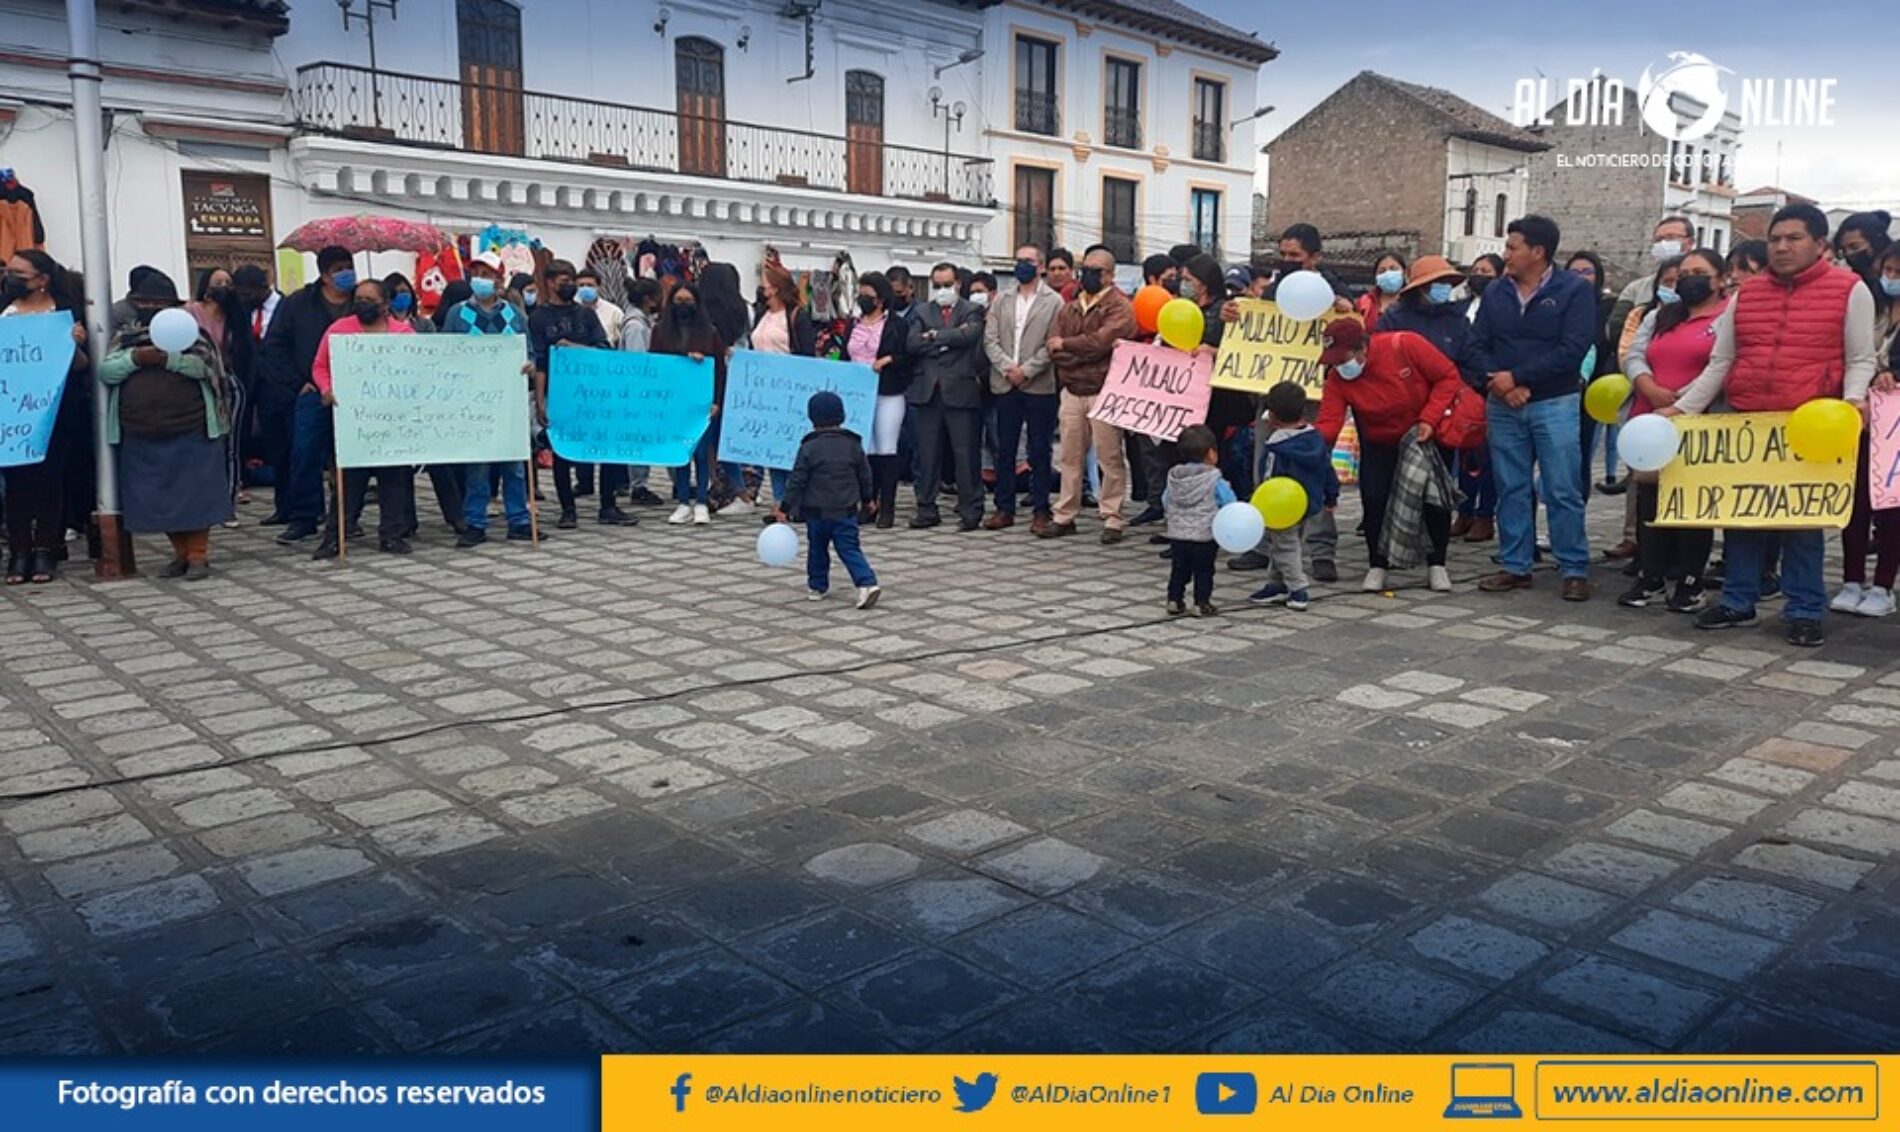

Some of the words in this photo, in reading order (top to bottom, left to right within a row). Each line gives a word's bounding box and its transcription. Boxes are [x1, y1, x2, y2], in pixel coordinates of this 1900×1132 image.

[201, 214, 261, 225] ENTRADA
[1121, 354, 1198, 395] MULALÓ
[1218, 351, 1243, 378] AL
[1247, 353, 1273, 380] DR
[1095, 391, 1194, 439] PRESENTE
[1663, 486, 1689, 521] AL
[1695, 485, 1725, 520] DR
[1730, 482, 1852, 518] TINAJERO
